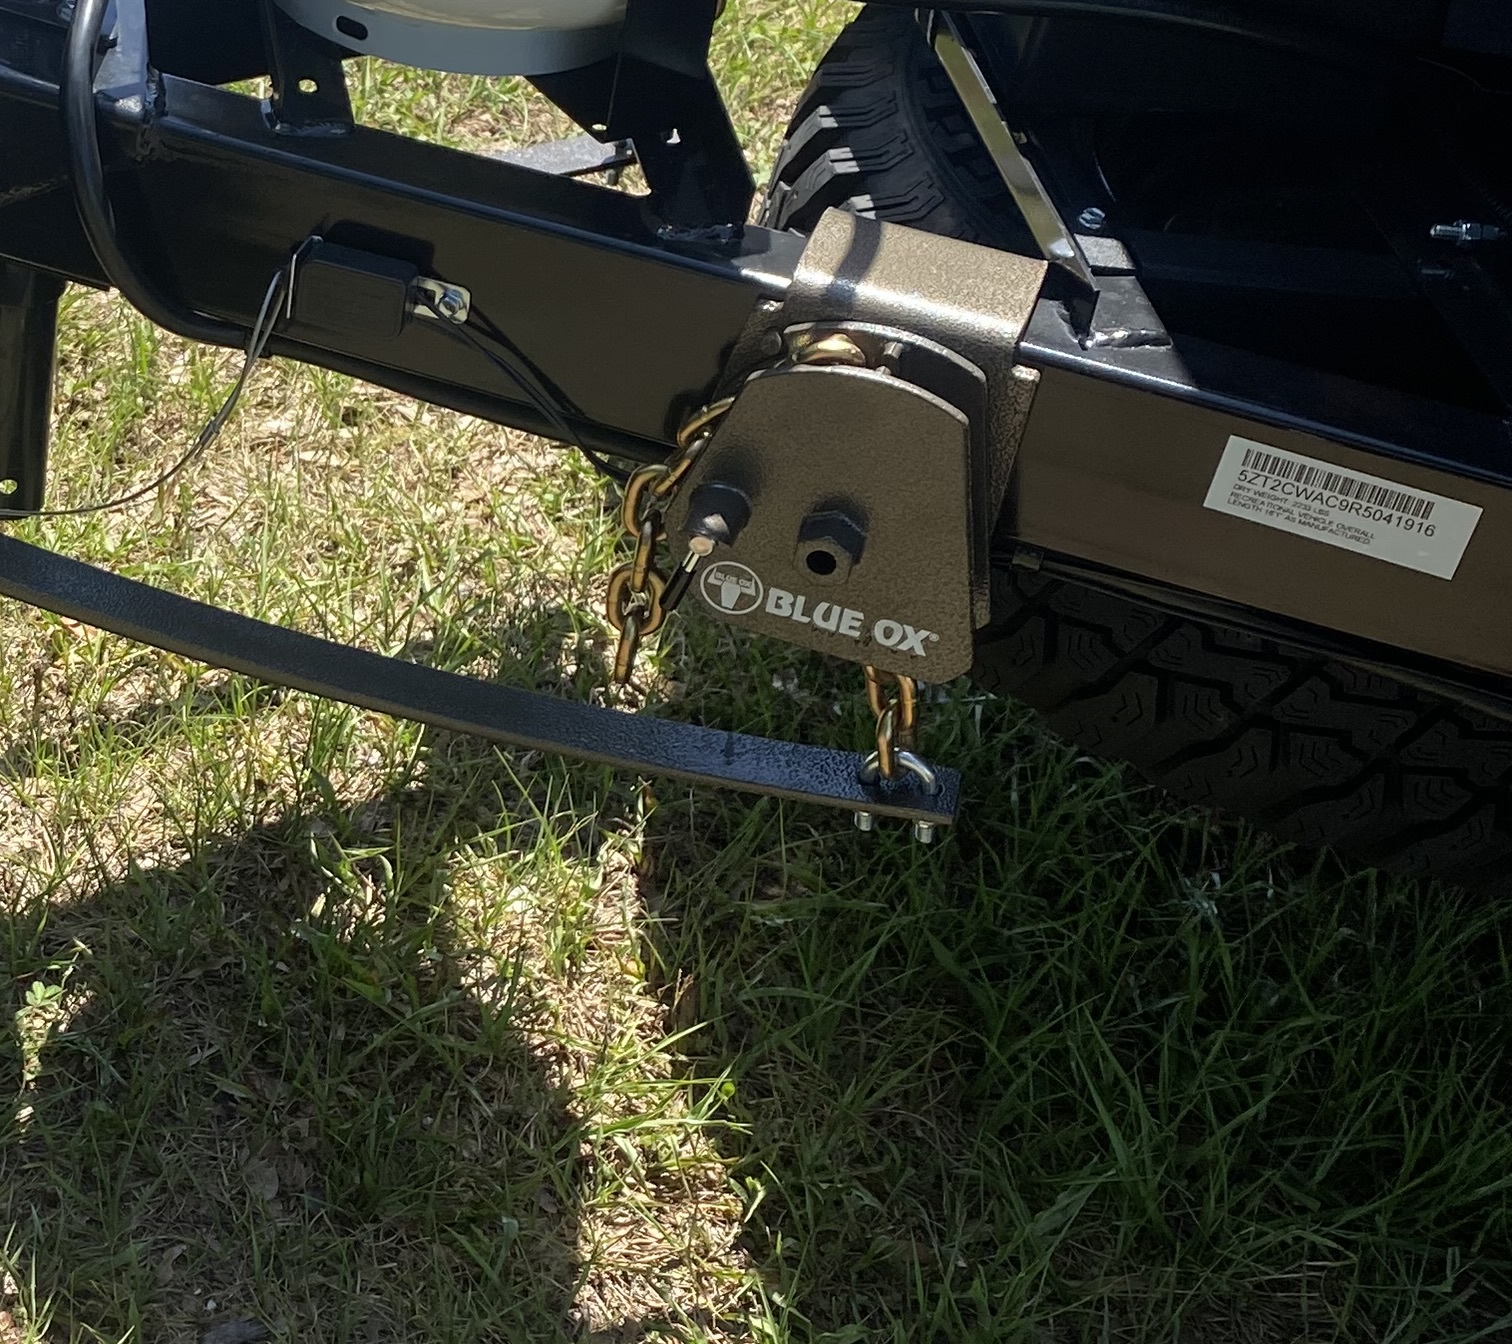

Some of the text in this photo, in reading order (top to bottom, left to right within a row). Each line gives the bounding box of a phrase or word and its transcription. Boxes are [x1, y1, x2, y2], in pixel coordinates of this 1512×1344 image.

[1227, 497, 1263, 513] LENGTH
[1237, 469, 1437, 538] 5ZT2CWAC9R5041916
[1298, 509, 1335, 526] VEHICLE
[1336, 521, 1376, 540] OVERALL
[765, 587, 864, 638] BLUE
